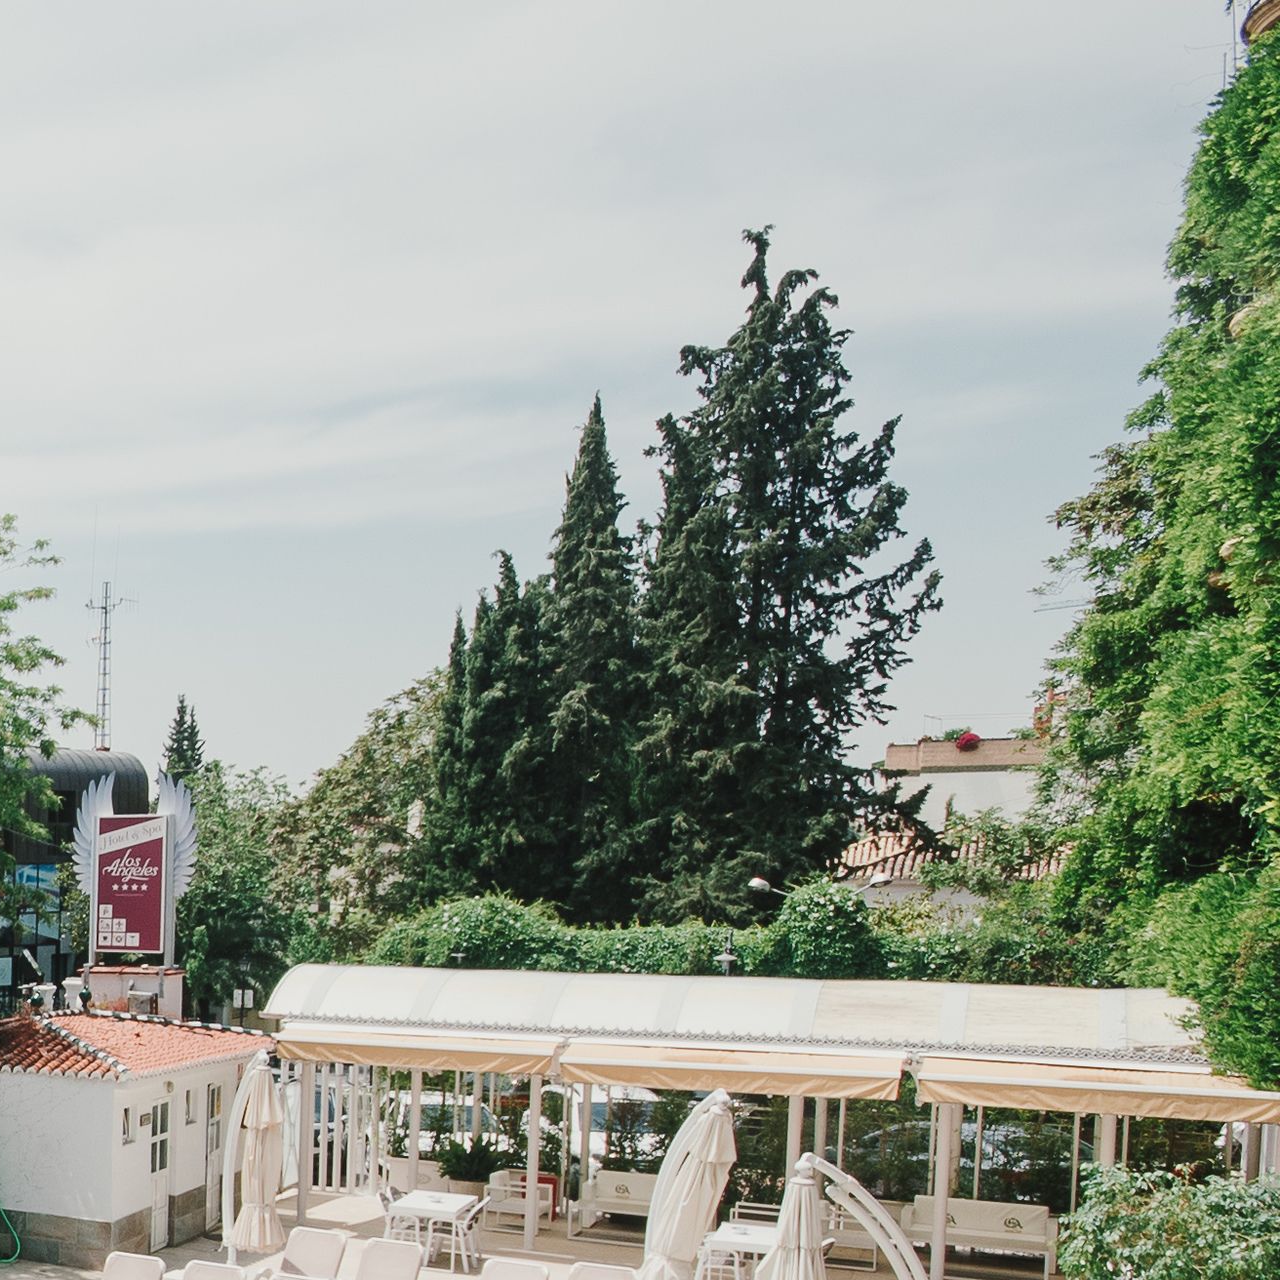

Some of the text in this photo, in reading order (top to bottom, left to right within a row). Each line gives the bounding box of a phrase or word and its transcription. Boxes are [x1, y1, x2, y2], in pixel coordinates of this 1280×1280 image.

[101, 831, 129, 850] Hotel
[143, 825, 162, 837] Spa
[102, 858, 159, 883] Angeles
